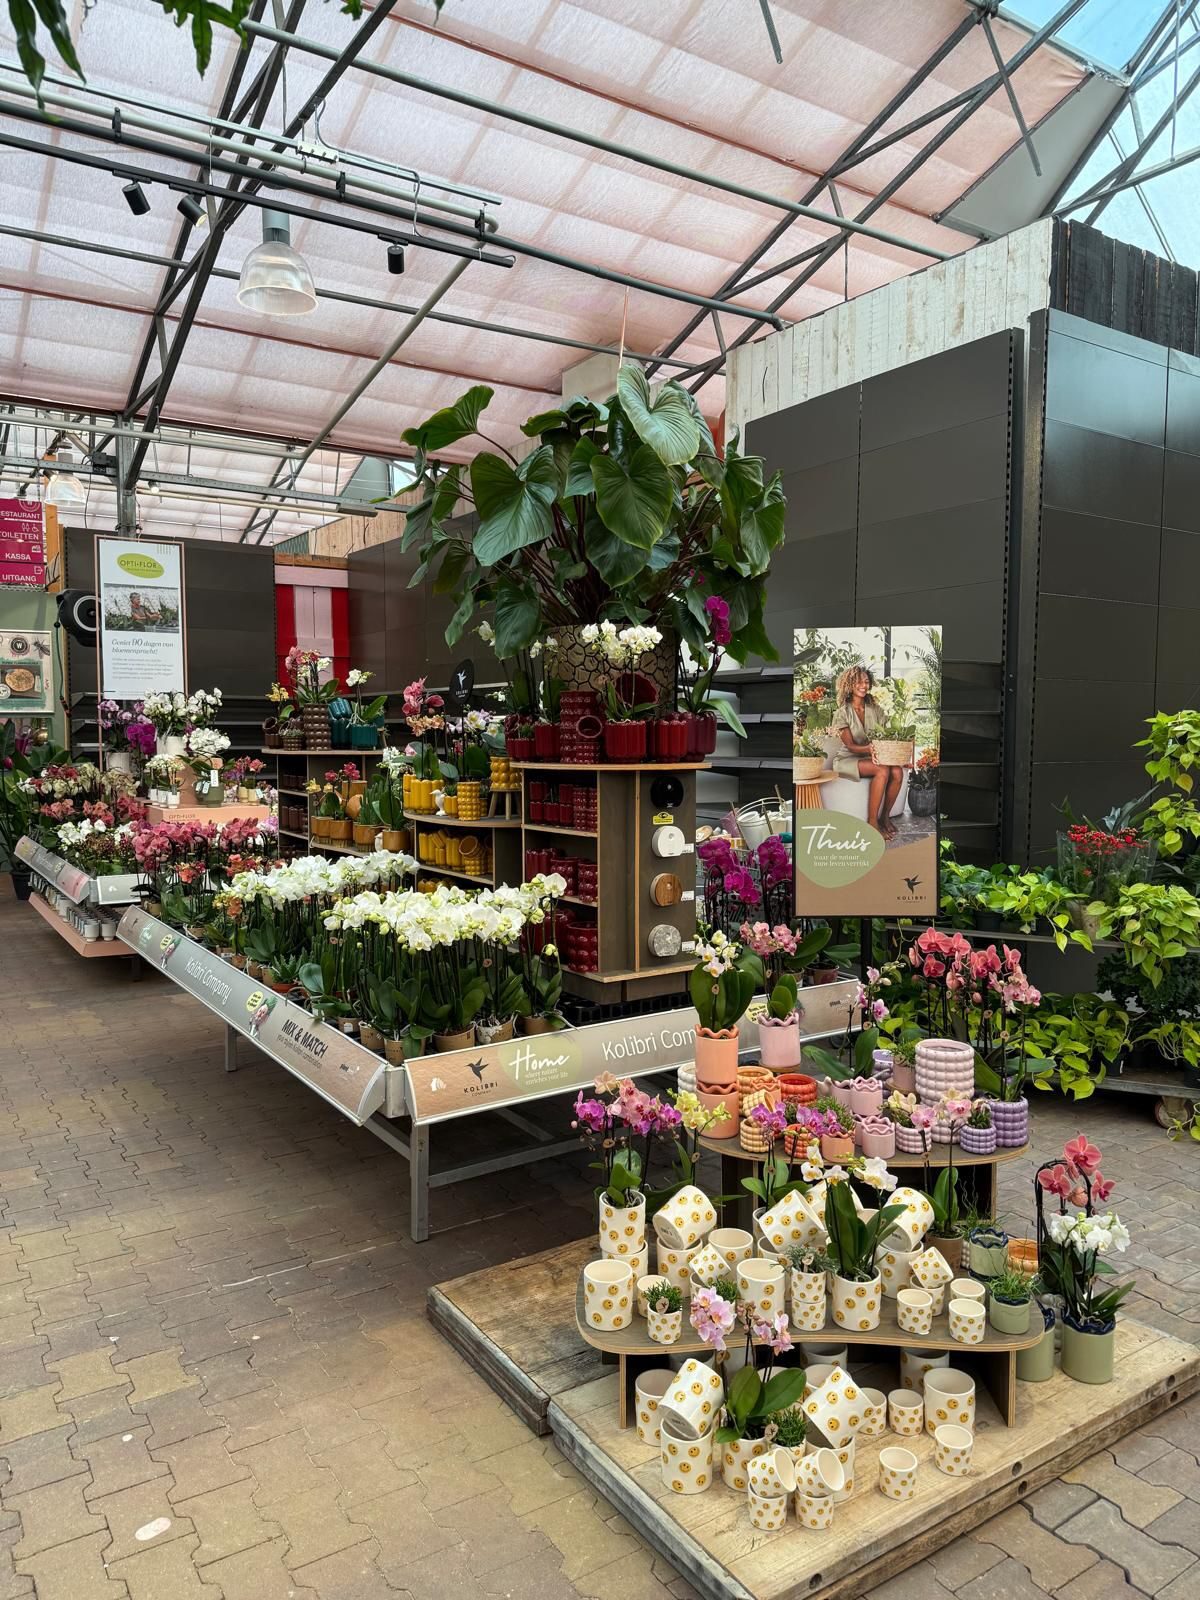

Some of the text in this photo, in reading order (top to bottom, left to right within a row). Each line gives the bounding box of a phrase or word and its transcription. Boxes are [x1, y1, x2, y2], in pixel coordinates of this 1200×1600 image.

[0, 510, 41, 519] ESTAURANT
[5, 552, 31, 560] KASSA
[2, 574, 37, 582] UITGANG
[800, 823, 872, 855] Thuis
[185, 957, 207, 981] Kolibri
[202, 969, 233, 1006] Company
[281, 1019, 328, 1058] MIX & MATCH
[601, 1031, 658, 1061] Kolibri
[508, 1044, 570, 1080] Home
[463, 1081, 499, 1094] KOLIBRI
